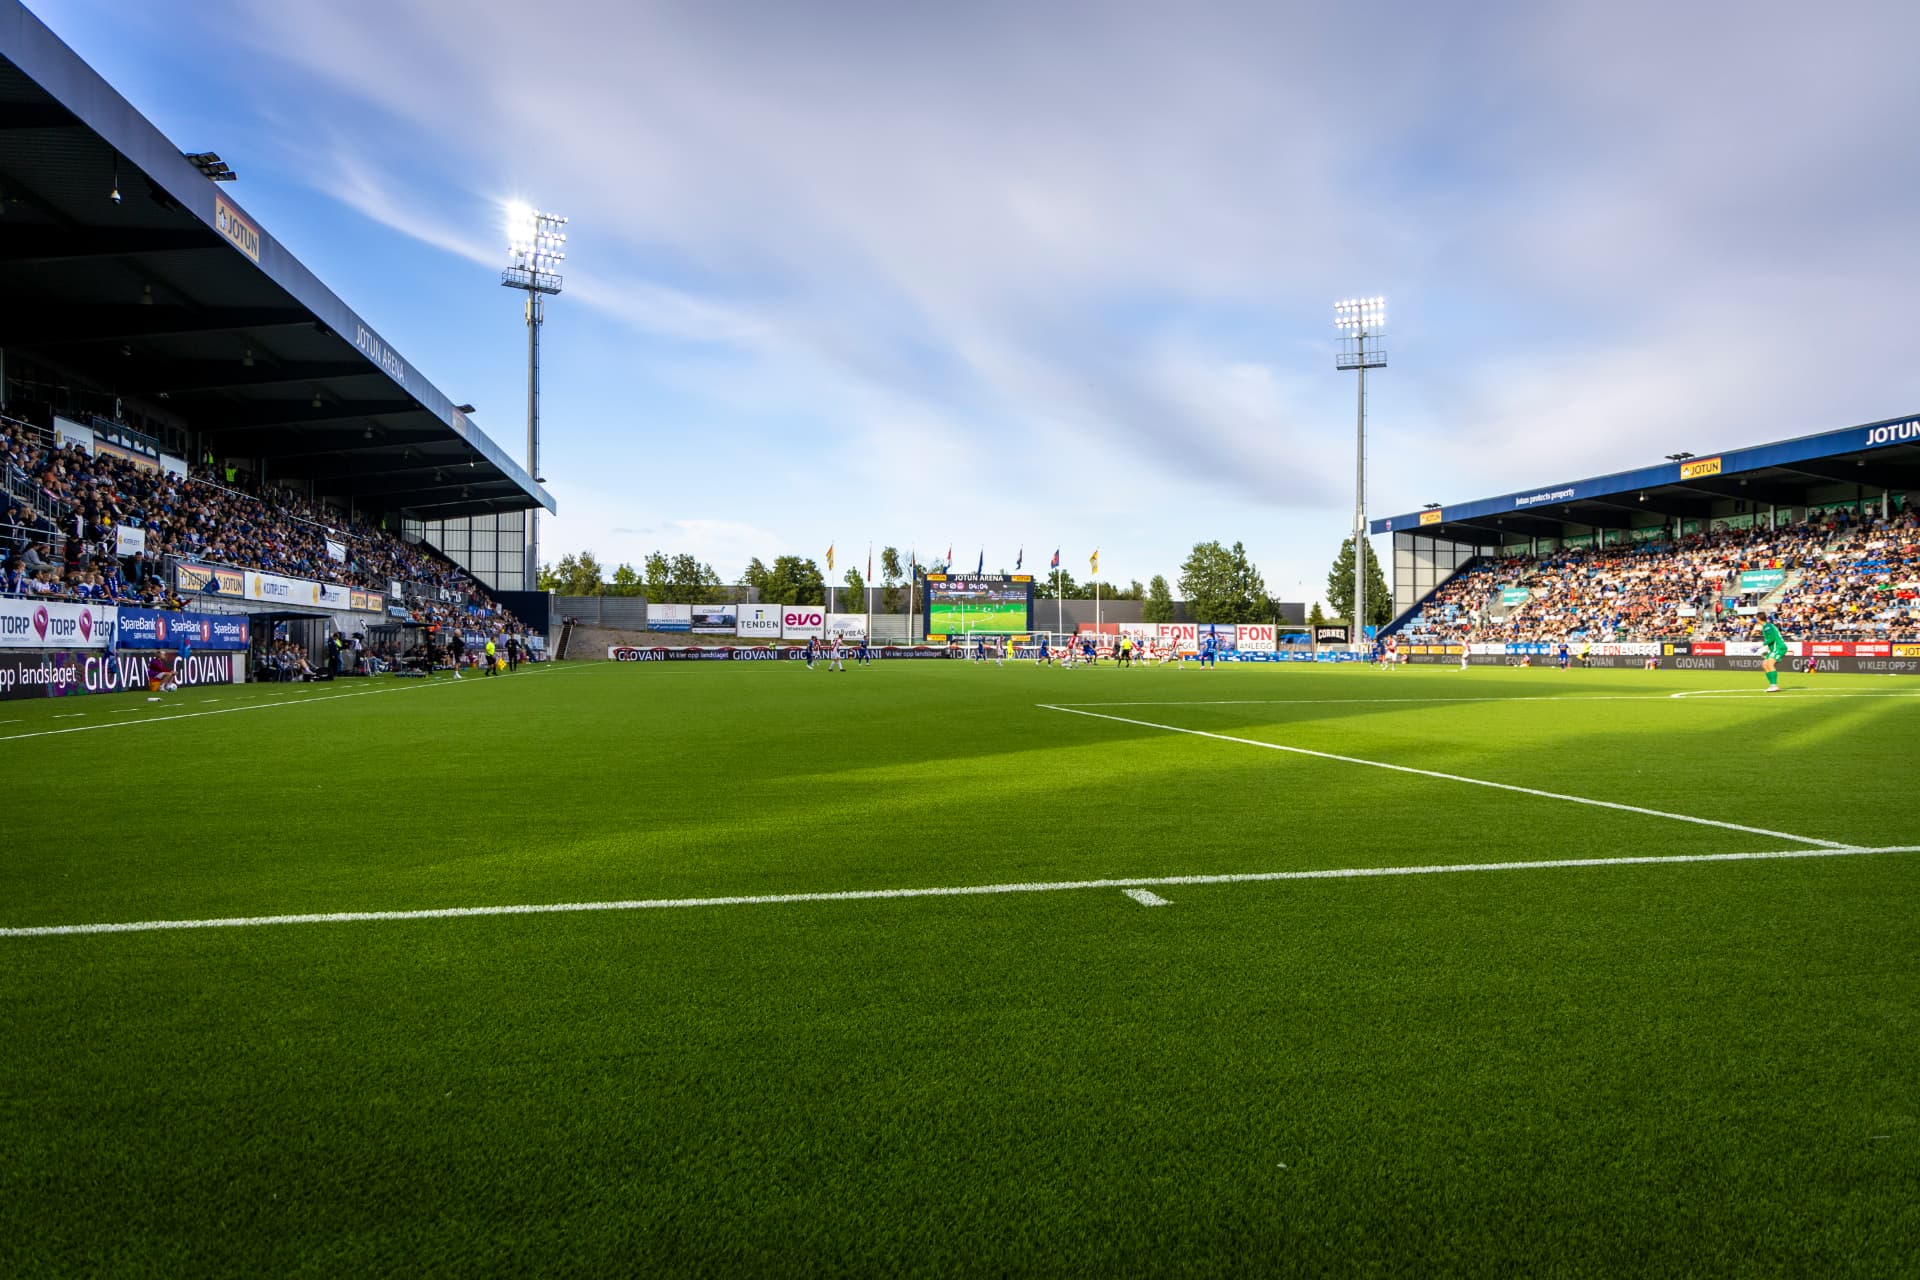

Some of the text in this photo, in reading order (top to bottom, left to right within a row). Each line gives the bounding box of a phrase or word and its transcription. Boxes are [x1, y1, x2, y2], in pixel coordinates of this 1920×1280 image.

[228, 214, 258, 257] JOTUN
[356, 324, 405, 384] JOTUN ARENA
[1866, 420, 1920, 446] JOTUN
[1690, 461, 1719, 476] JOTUN
[222, 578, 242, 592] JOTUN
[263, 582, 289, 596] KOMPLETT
[1, 615, 30, 634] TORP
[120, 616, 156, 632] SpareBank
[171, 619, 200, 634] SpareBank
[741, 620, 779, 629] TENDEN
[784, 613, 822, 626] evo
[50, 618, 77, 636] TORP
[214, 622, 240, 636] SpareBank
[857, 628, 865, 636] AS
[1159, 626, 1195, 640] FON
[1238, 626, 1272, 641] FON
[1317, 628, 1346, 641] CORNER
[1160, 642, 1195, 650] ANGG
[1603, 645, 1621, 656] FON
[1621, 645, 1658, 656] ANLEGG
[618, 650, 665, 661] GOVANI
[732, 650, 778, 660] GIOVANI
[789, 650, 833, 660] GIOANI
[839, 649, 882, 659] GIONI
[174, 655, 229, 685] GIOVANI
[1675, 658, 1715, 669] GIOVANI
[1857, 661, 1918, 671] VI KLER OPP SF
[19, 661, 77, 688] landslaget
[85, 656, 150, 690] GIOVAN
